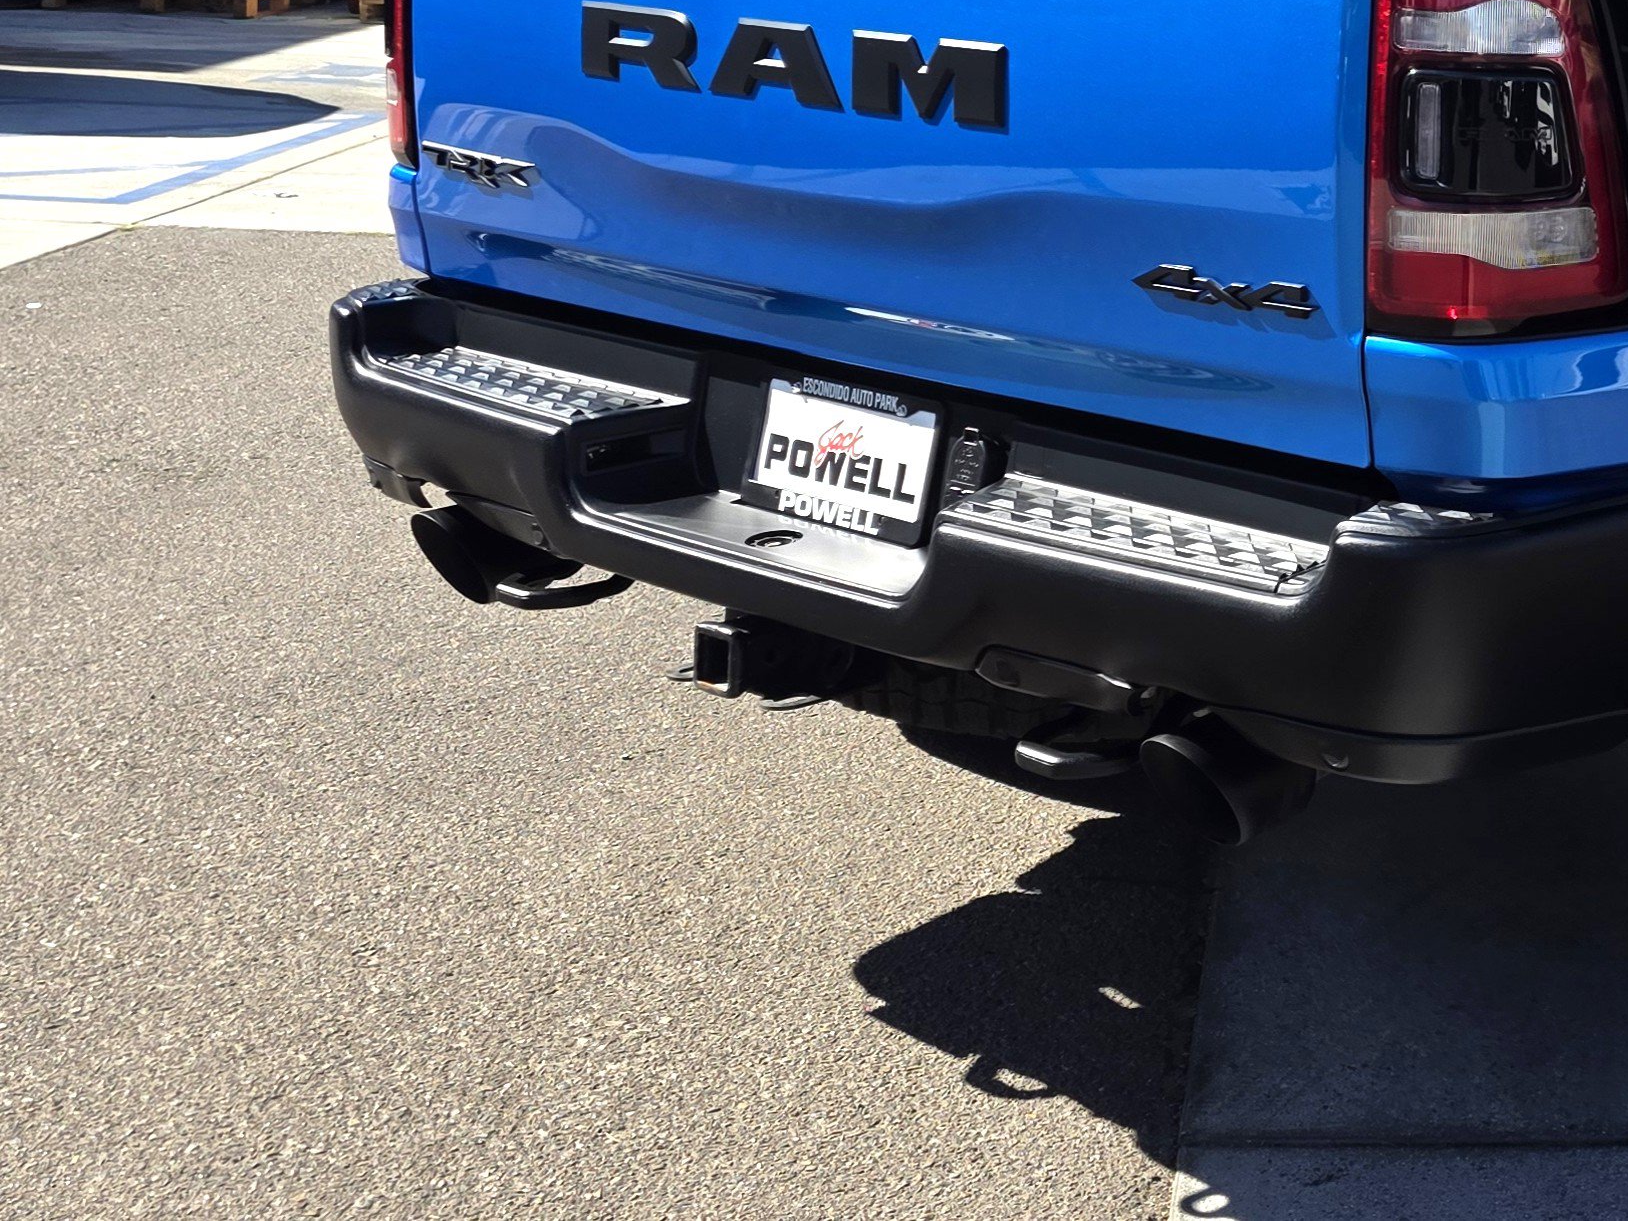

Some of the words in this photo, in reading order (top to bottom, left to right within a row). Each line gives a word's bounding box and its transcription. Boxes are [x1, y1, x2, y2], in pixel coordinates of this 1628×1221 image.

[581, 0, 1009, 134] RAM
[421, 139, 536, 189] TRX
[1131, 263, 1322, 320] 4x4
[803, 376, 850, 402] ESCONDIDO
[850, 387, 873, 408] AUTO
[874, 392, 899, 413] PARK
[814, 419, 864, 466] Jack
[763, 432, 916, 505] POWELL
[777, 487, 881, 536] POWELL
